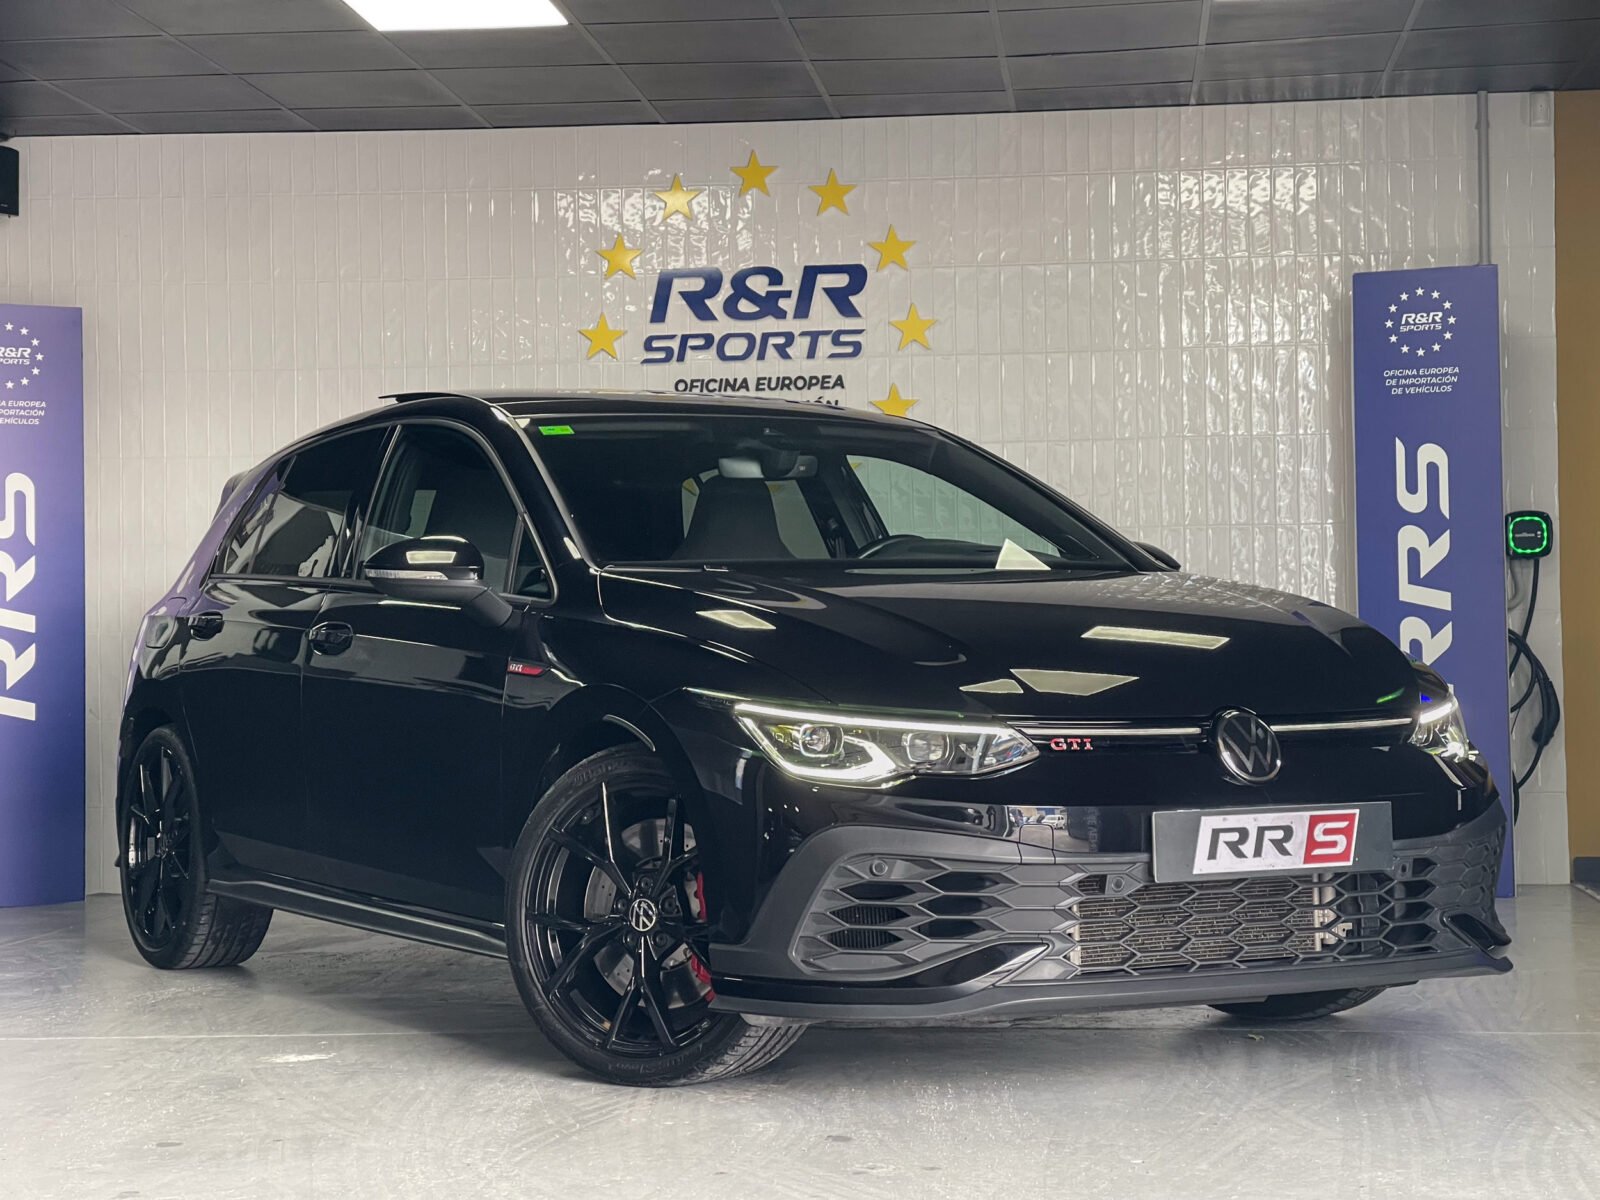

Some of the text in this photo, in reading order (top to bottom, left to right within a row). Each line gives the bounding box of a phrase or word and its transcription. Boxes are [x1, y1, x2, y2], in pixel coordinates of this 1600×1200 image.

[650, 264, 868, 323] R&R
[1401, 311, 1443, 324] R&R
[1400, 323, 1442, 332] SPORTS
[640, 329, 866, 364] SPORTS
[1383, 366, 1460, 377] OFICINA EUROPEA
[674, 375, 845, 393] OFICINA EUROPEA
[1385, 375, 1458, 386] DE IMPORTACIÓN
[1391, 385, 1452, 395] DE VEHÍCULOS
[8, 400, 46, 408] EUROPEA
[0, 408, 45, 416] PORTACIÓN
[0, 417, 40, 425] EHÍCULOS
[1050, 737, 1094, 751] GTI
[1206, 820, 1350, 862] RRS
